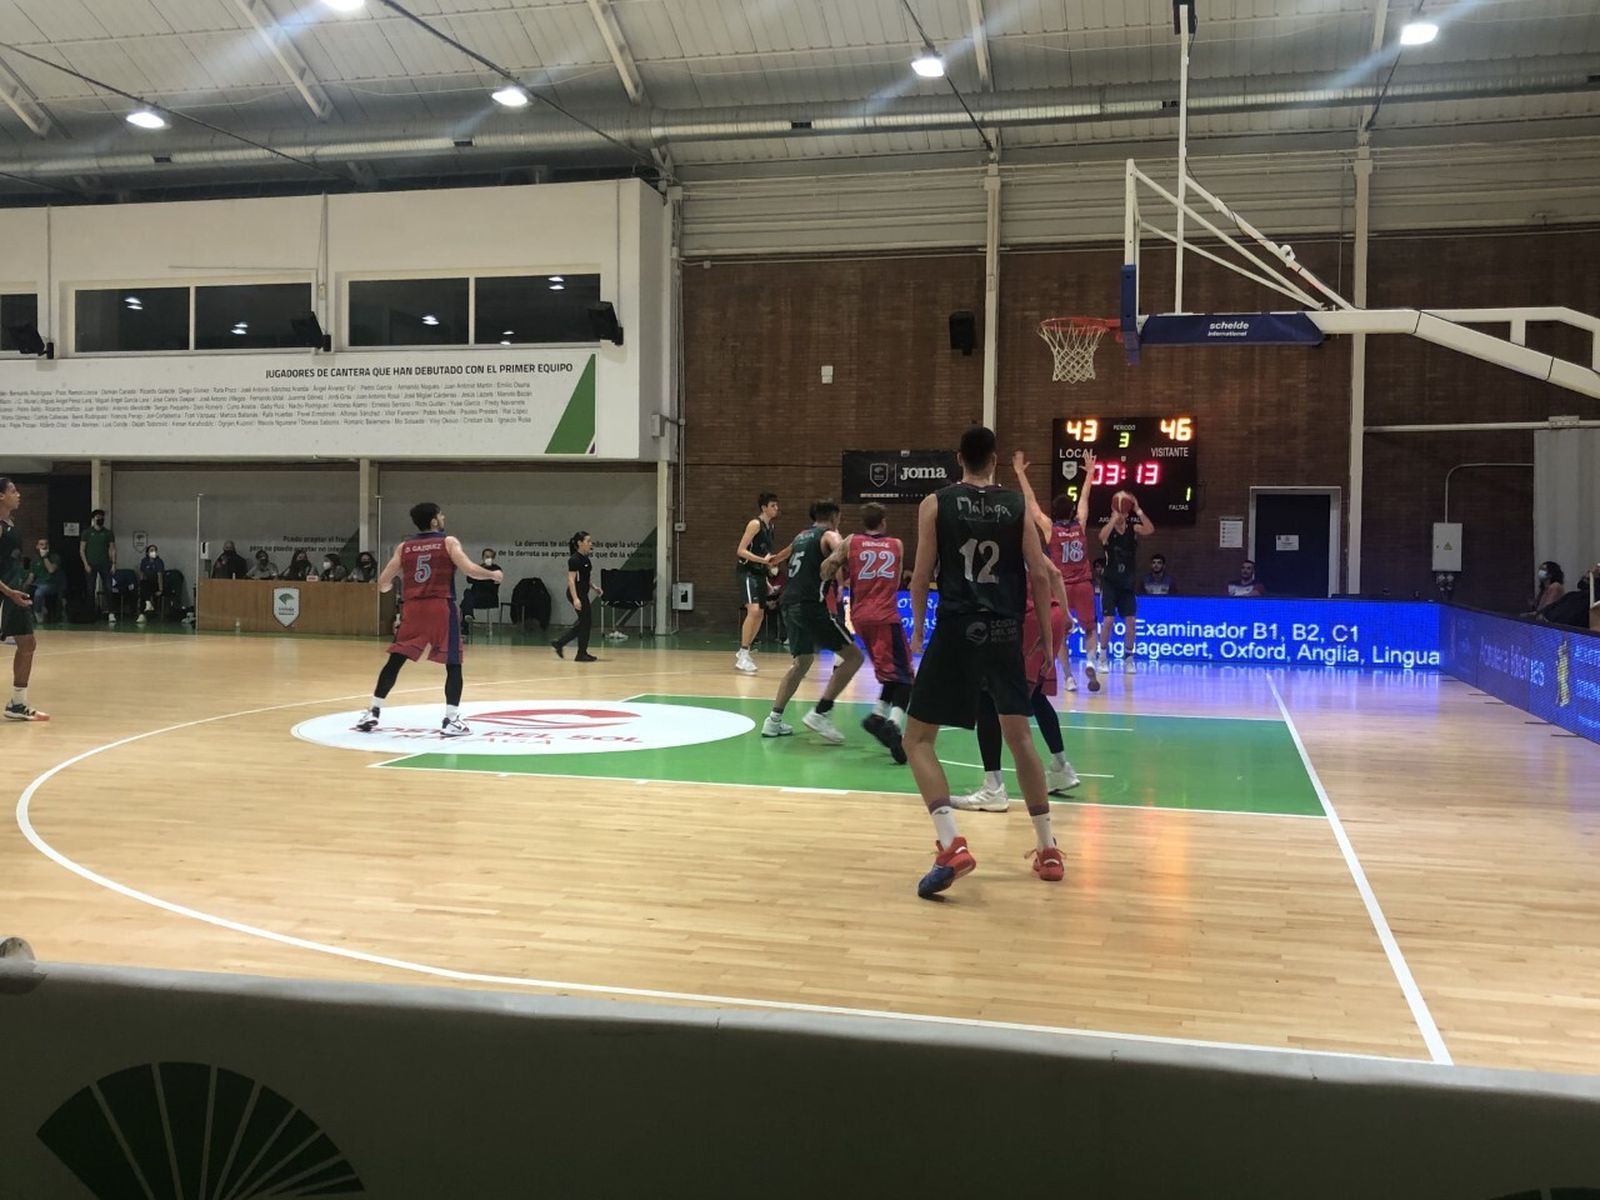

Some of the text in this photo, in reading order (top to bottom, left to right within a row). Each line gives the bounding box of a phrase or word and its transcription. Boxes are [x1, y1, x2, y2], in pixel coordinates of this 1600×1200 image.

[1209, 321, 1249, 330] schelde
[266, 363, 573, 378] JUGADORES DE CANTERA QUE HAN DEBUTADO CON EL PRIMER EQUIPO
[1066, 419, 1098, 442] 43
[1119, 432, 1130, 448] 3
[1161, 418, 1192, 441] 46
[1059, 448, 1096, 458] LOCAL
[1151, 447, 1189, 457] VISITANTE
[1185, 487, 1192, 501] 1
[956, 496, 1012, 523] Málaga
[959, 538, 999, 583] 12
[1061, 538, 1083, 563] 18
[415, 553, 431, 583] 5
[858, 550, 895, 580] 22
[1135, 618, 1247, 641] Examinador
[1253, 622, 1285, 642] B1,
[1293, 623, 1325, 643] B2,
[1333, 624, 1358, 642] C1
[1220, 641, 1291, 662] Oxford,
[1296, 643, 1365, 666] Anglia,
[1372, 646, 1440, 668] Lingua
